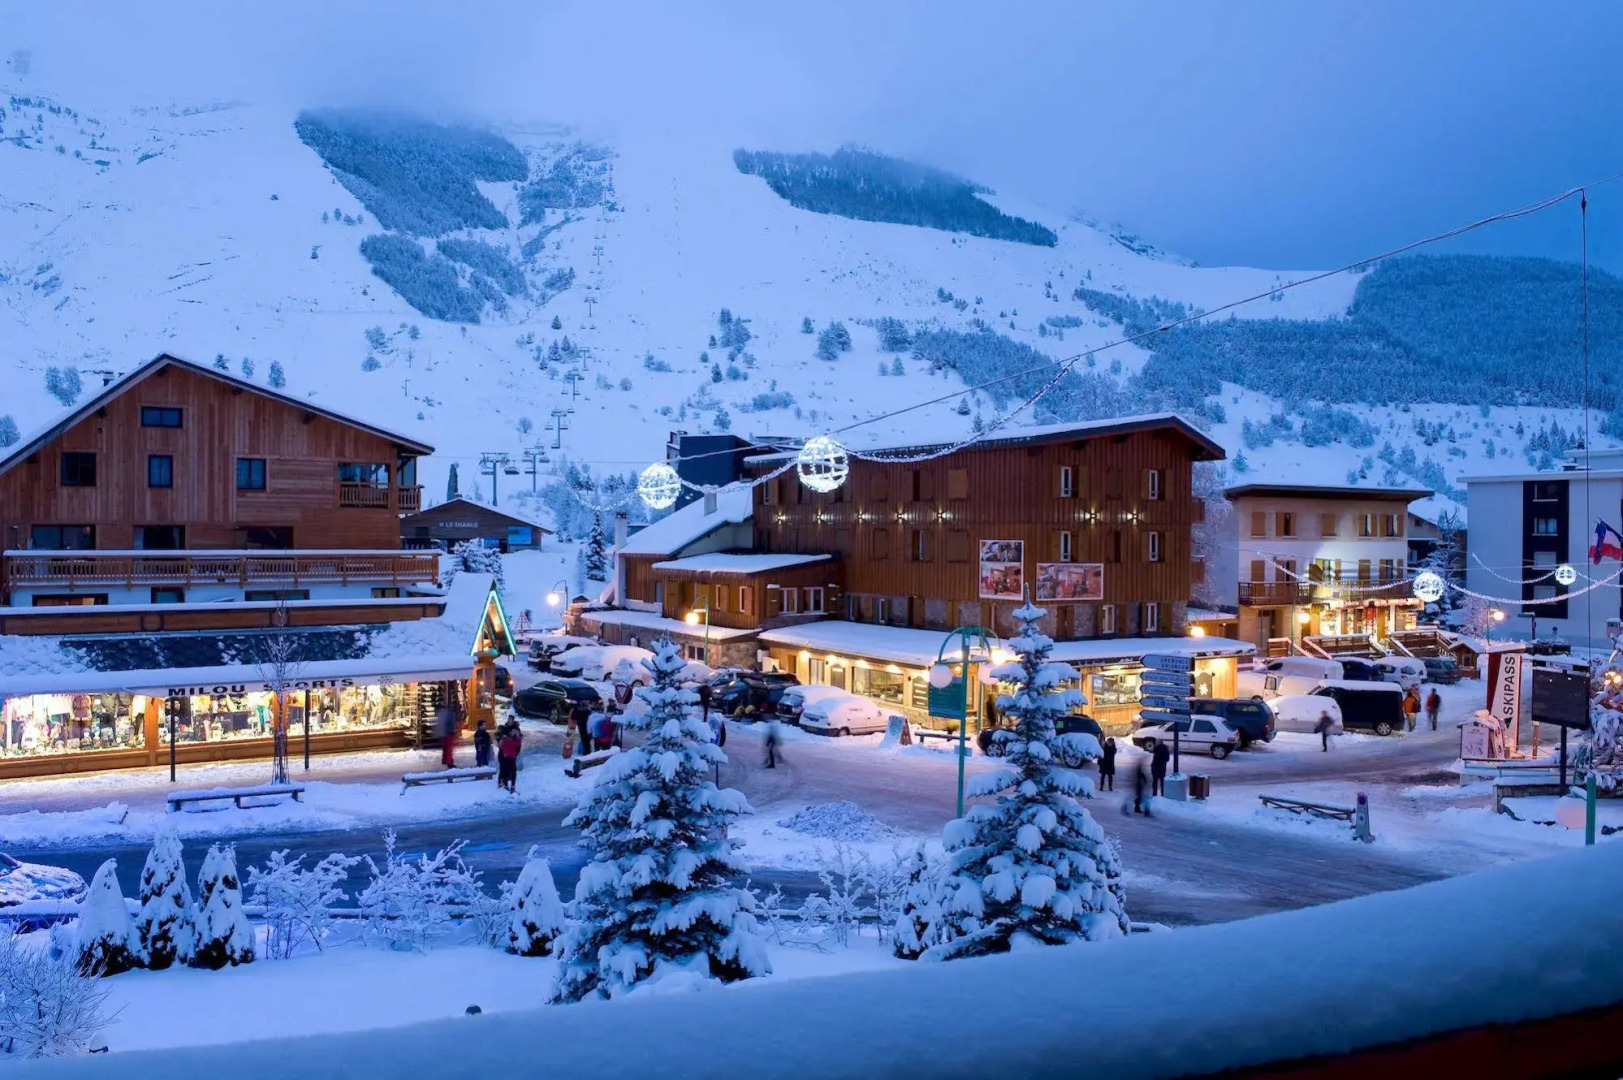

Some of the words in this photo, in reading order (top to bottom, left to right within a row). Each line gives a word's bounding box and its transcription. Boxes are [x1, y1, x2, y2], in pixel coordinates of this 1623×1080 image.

[168, 685, 245, 697] MILOU
[263, 679, 355, 692] SPORTS
[1503, 656, 1516, 715] SKIPASS
